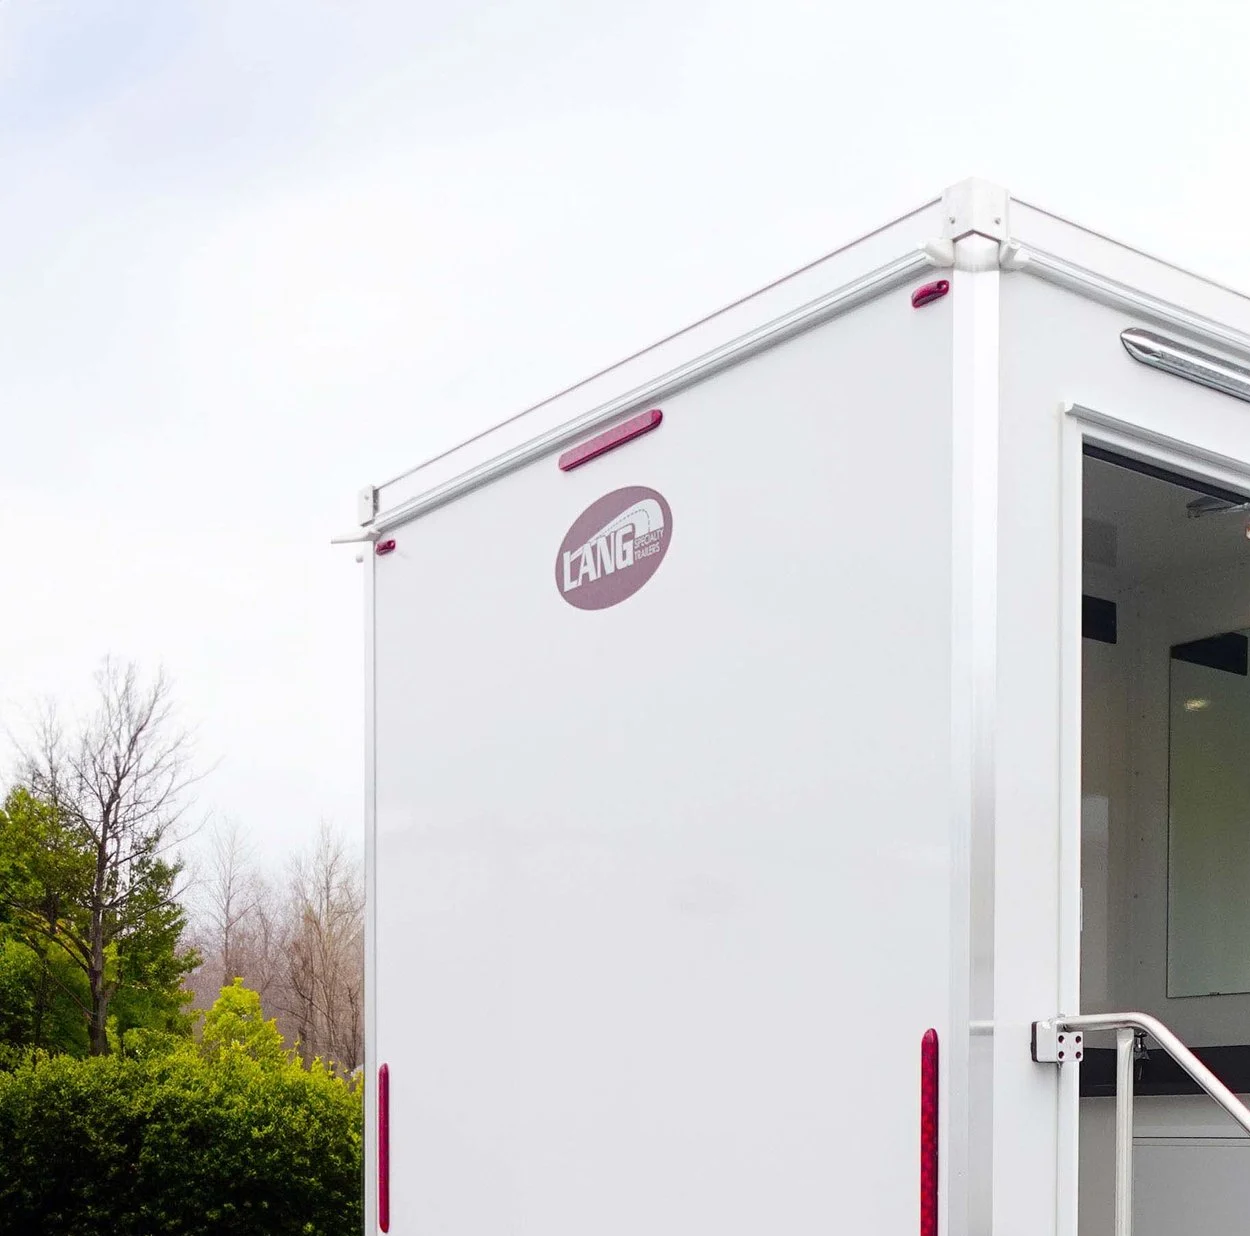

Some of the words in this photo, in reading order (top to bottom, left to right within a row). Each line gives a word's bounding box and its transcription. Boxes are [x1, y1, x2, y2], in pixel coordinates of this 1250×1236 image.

[633, 528, 664, 549] SPECIALTY
[562, 523, 634, 592] LANG
[634, 541, 661, 560] TRAILERS
